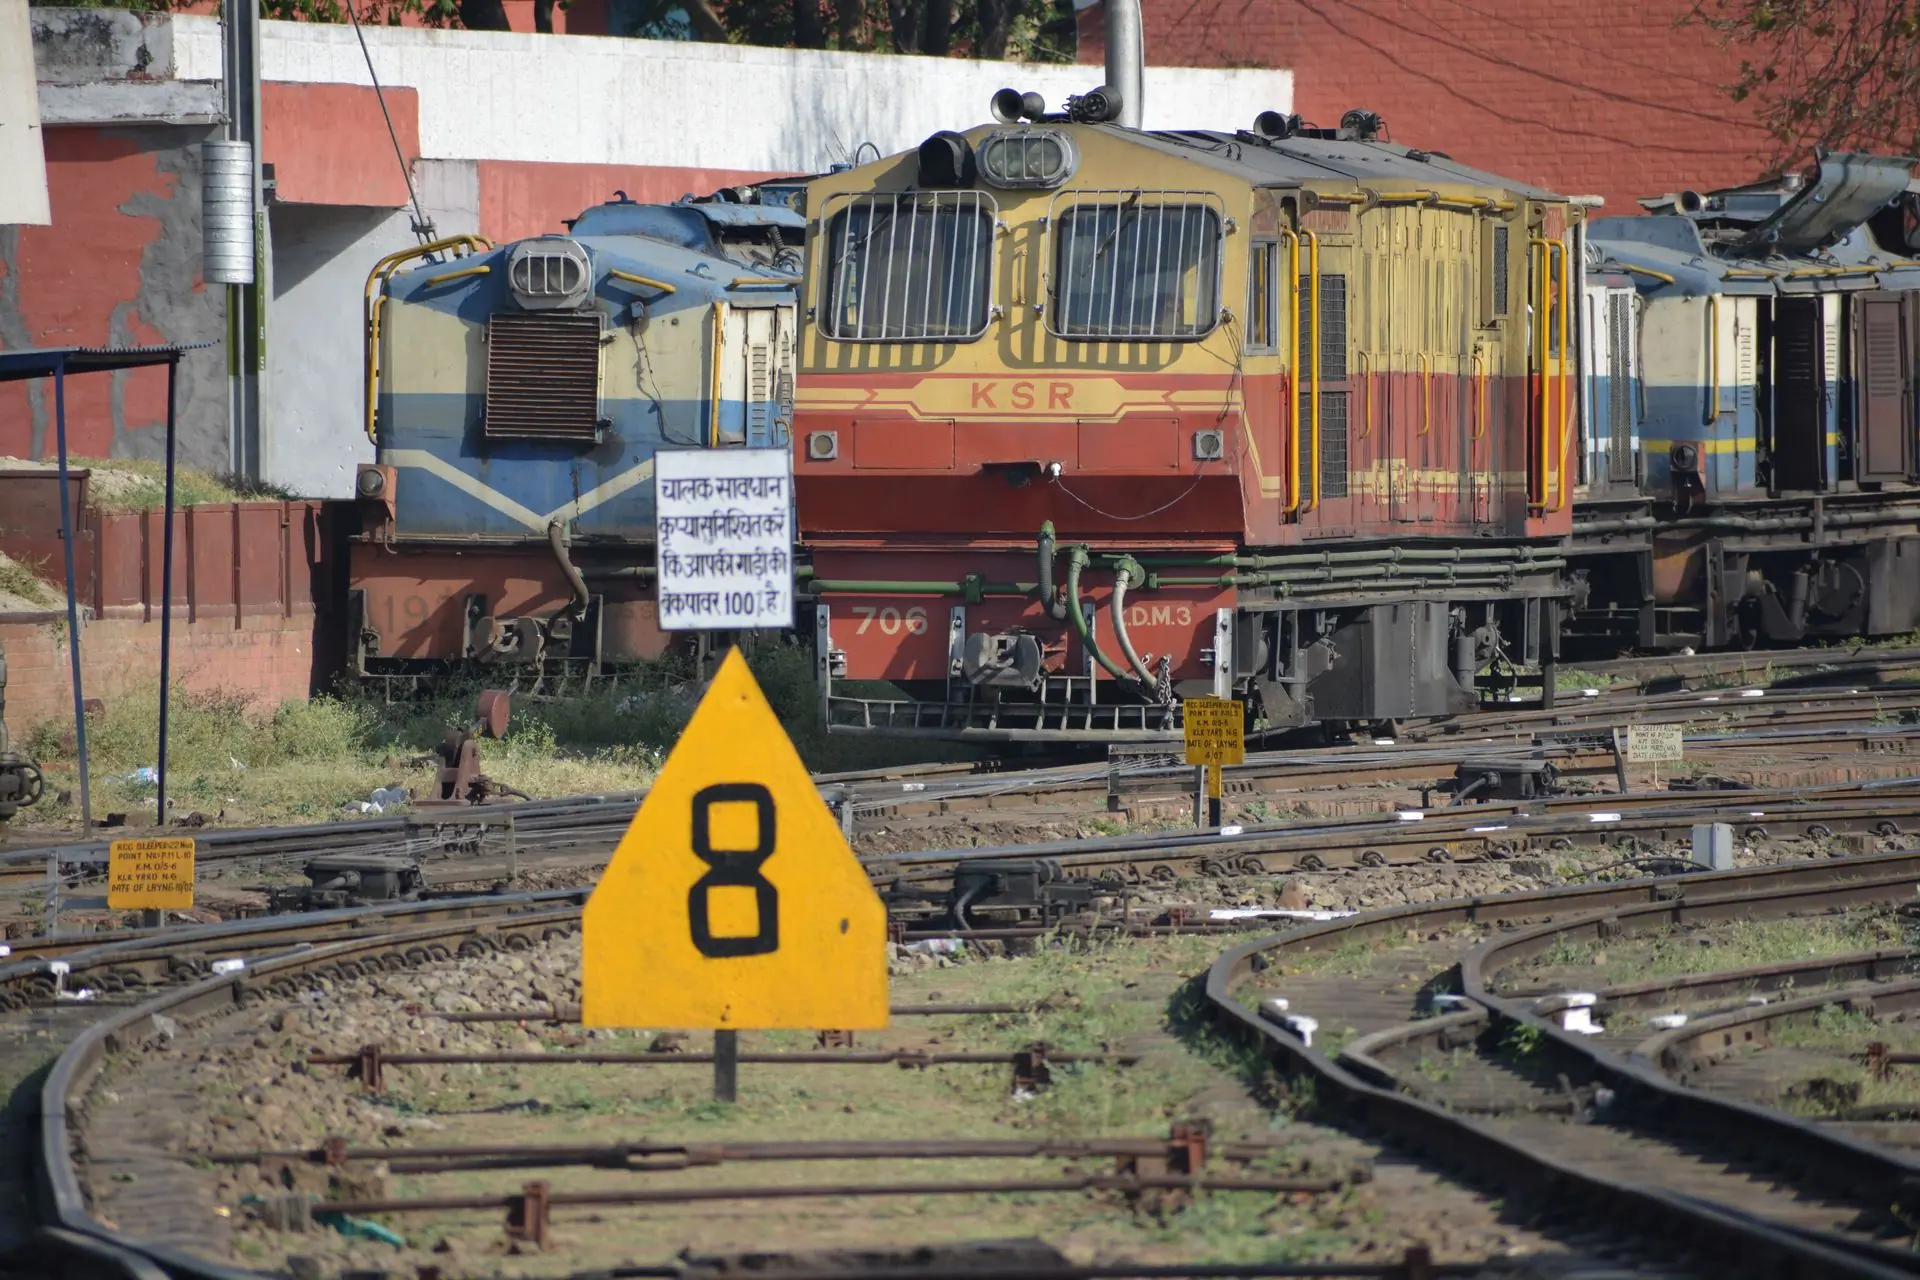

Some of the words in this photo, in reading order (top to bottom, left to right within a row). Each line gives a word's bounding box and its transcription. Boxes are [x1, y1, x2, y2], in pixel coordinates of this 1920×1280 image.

[971, 381, 1074, 409] KSR
[661, 478, 713, 504] चालक
[715, 476, 785, 502] सावधान
[763, 506, 785, 537] करें
[661, 549, 683, 578] कि
[768, 547, 787, 575] की
[852, 606, 928, 635] 706
[1116, 606, 1191, 627] .D.M.3
[1204, 739, 1212, 748] OF
[118, 852, 141, 860] POINT
[688, 783, 778, 958] 8
[111, 884, 131, 892] DATE
[133, 883, 144, 892] OF
